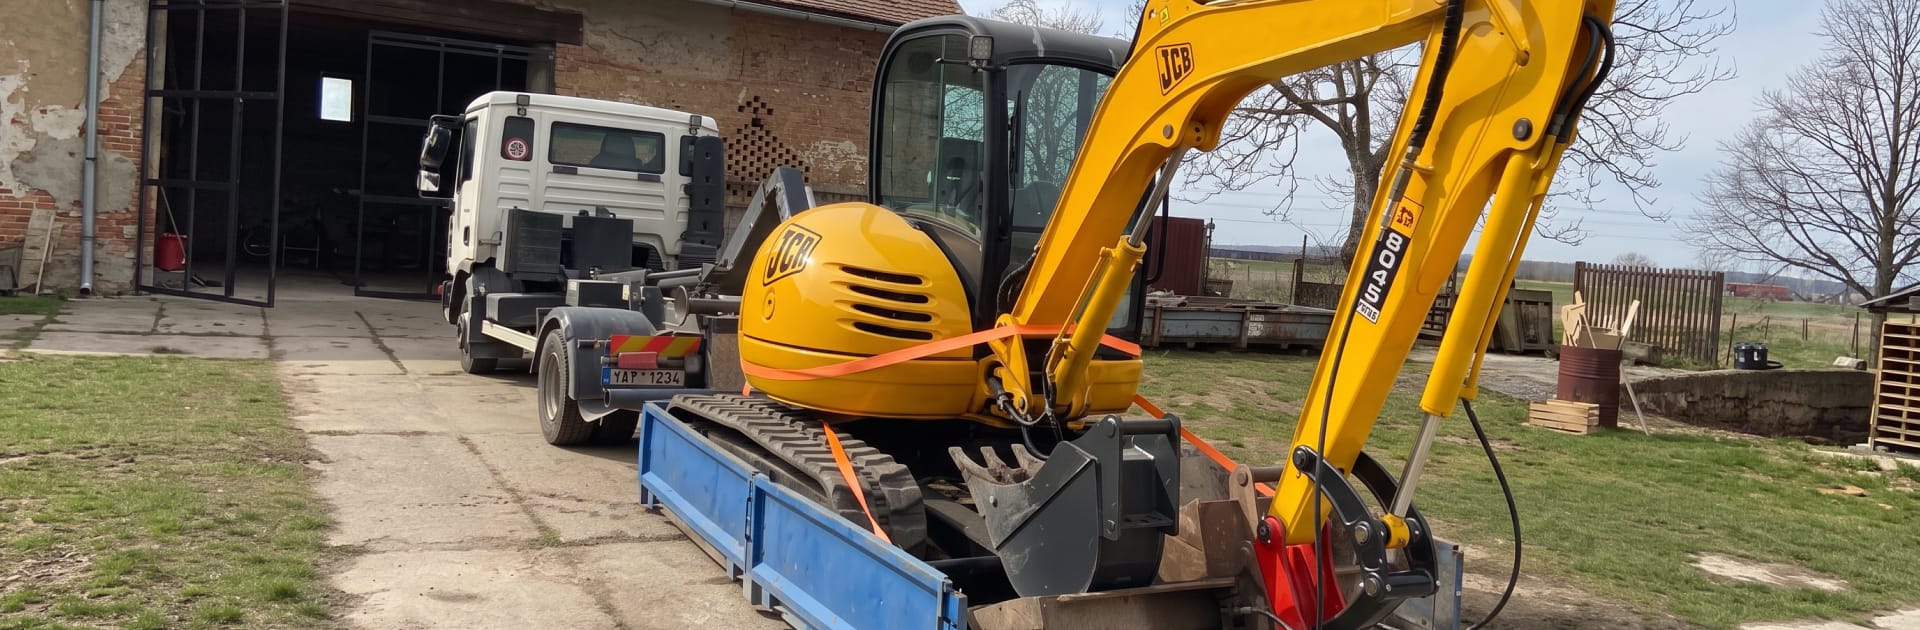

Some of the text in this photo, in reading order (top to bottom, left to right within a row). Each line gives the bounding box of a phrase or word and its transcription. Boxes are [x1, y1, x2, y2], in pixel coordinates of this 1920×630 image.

[1161, 47, 1191, 89] JCB
[1364, 232, 1403, 303] 8045
[614, 371, 680, 384] YAP 1234
